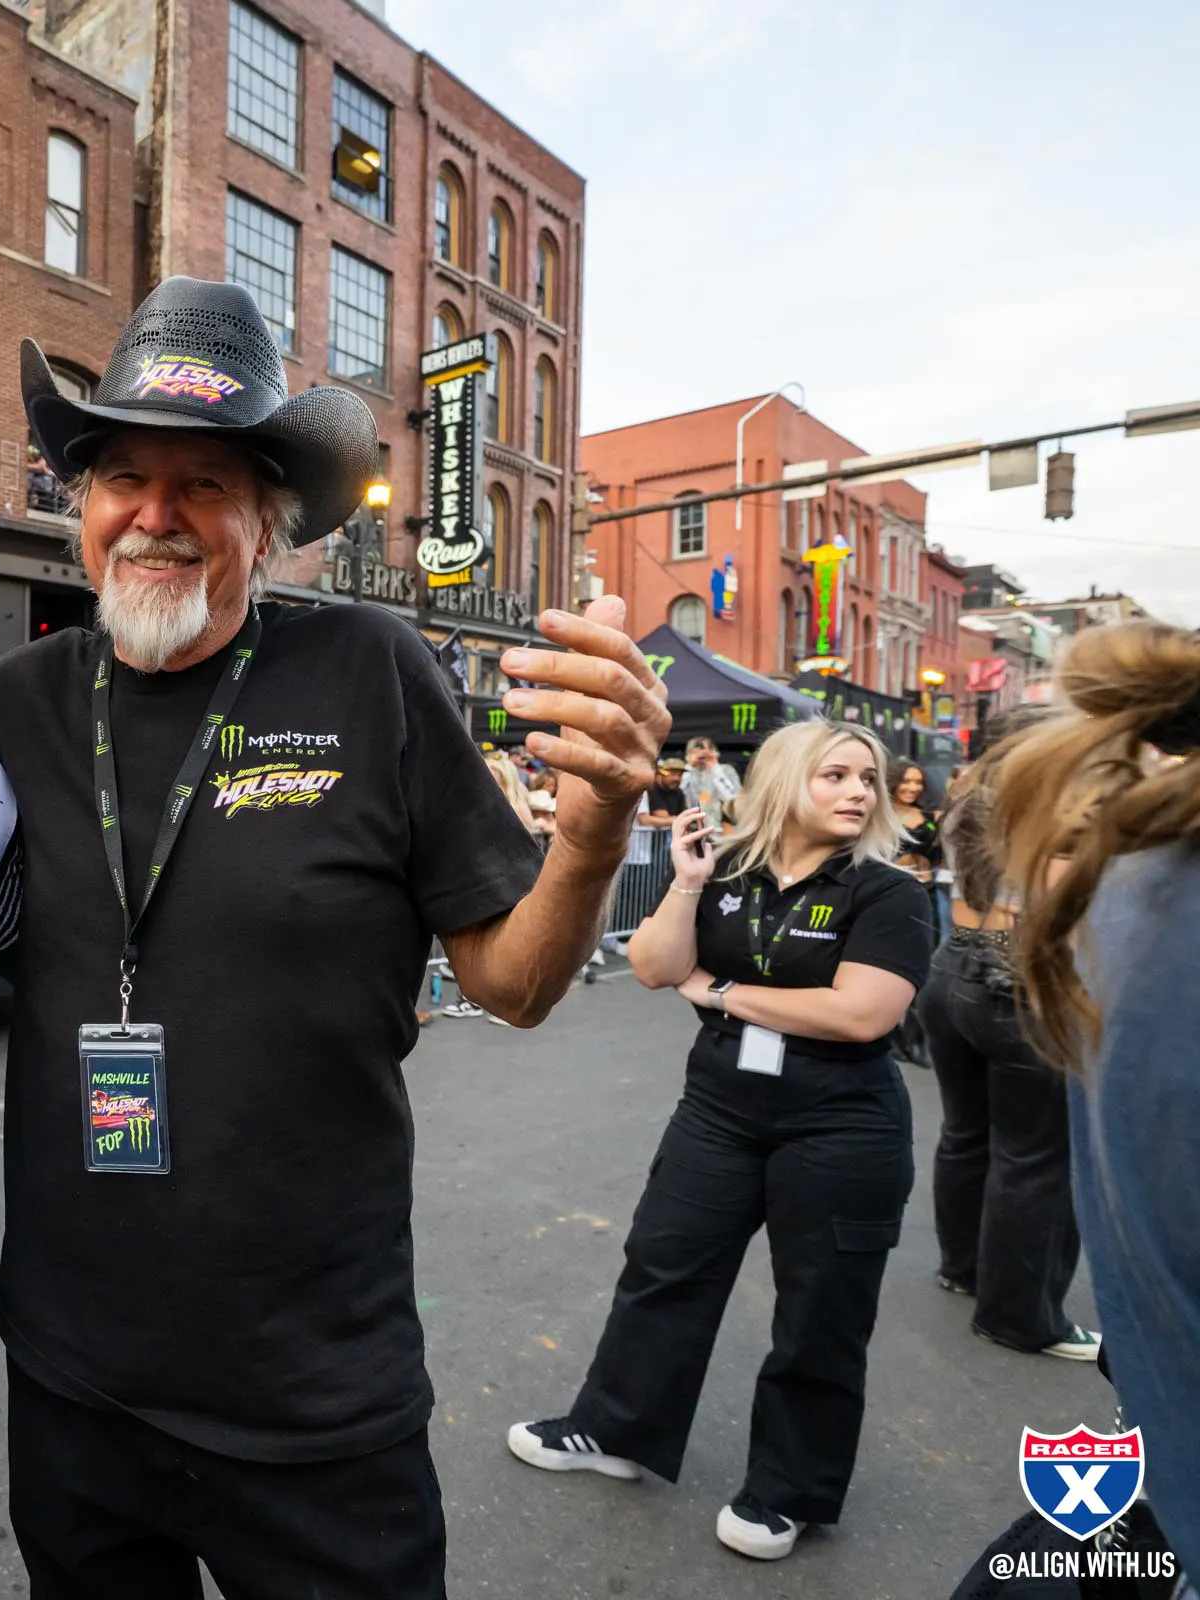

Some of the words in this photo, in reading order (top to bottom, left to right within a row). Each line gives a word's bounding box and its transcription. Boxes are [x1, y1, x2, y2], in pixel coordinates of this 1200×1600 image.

[132, 363, 246, 396] HOLESHOT
[437, 377, 466, 538] WHISKEY
[424, 540, 475, 573] Row
[335, 555, 417, 602] DERKS
[262, 747, 327, 756] ENERGY
[213, 769, 345, 809] HOLESHOT
[225, 787, 323, 819] KING
[789, 927, 837, 940] Kawasaki
[91, 1073, 150, 1085] NASHVILLE
[96, 1130, 125, 1156] FOP
